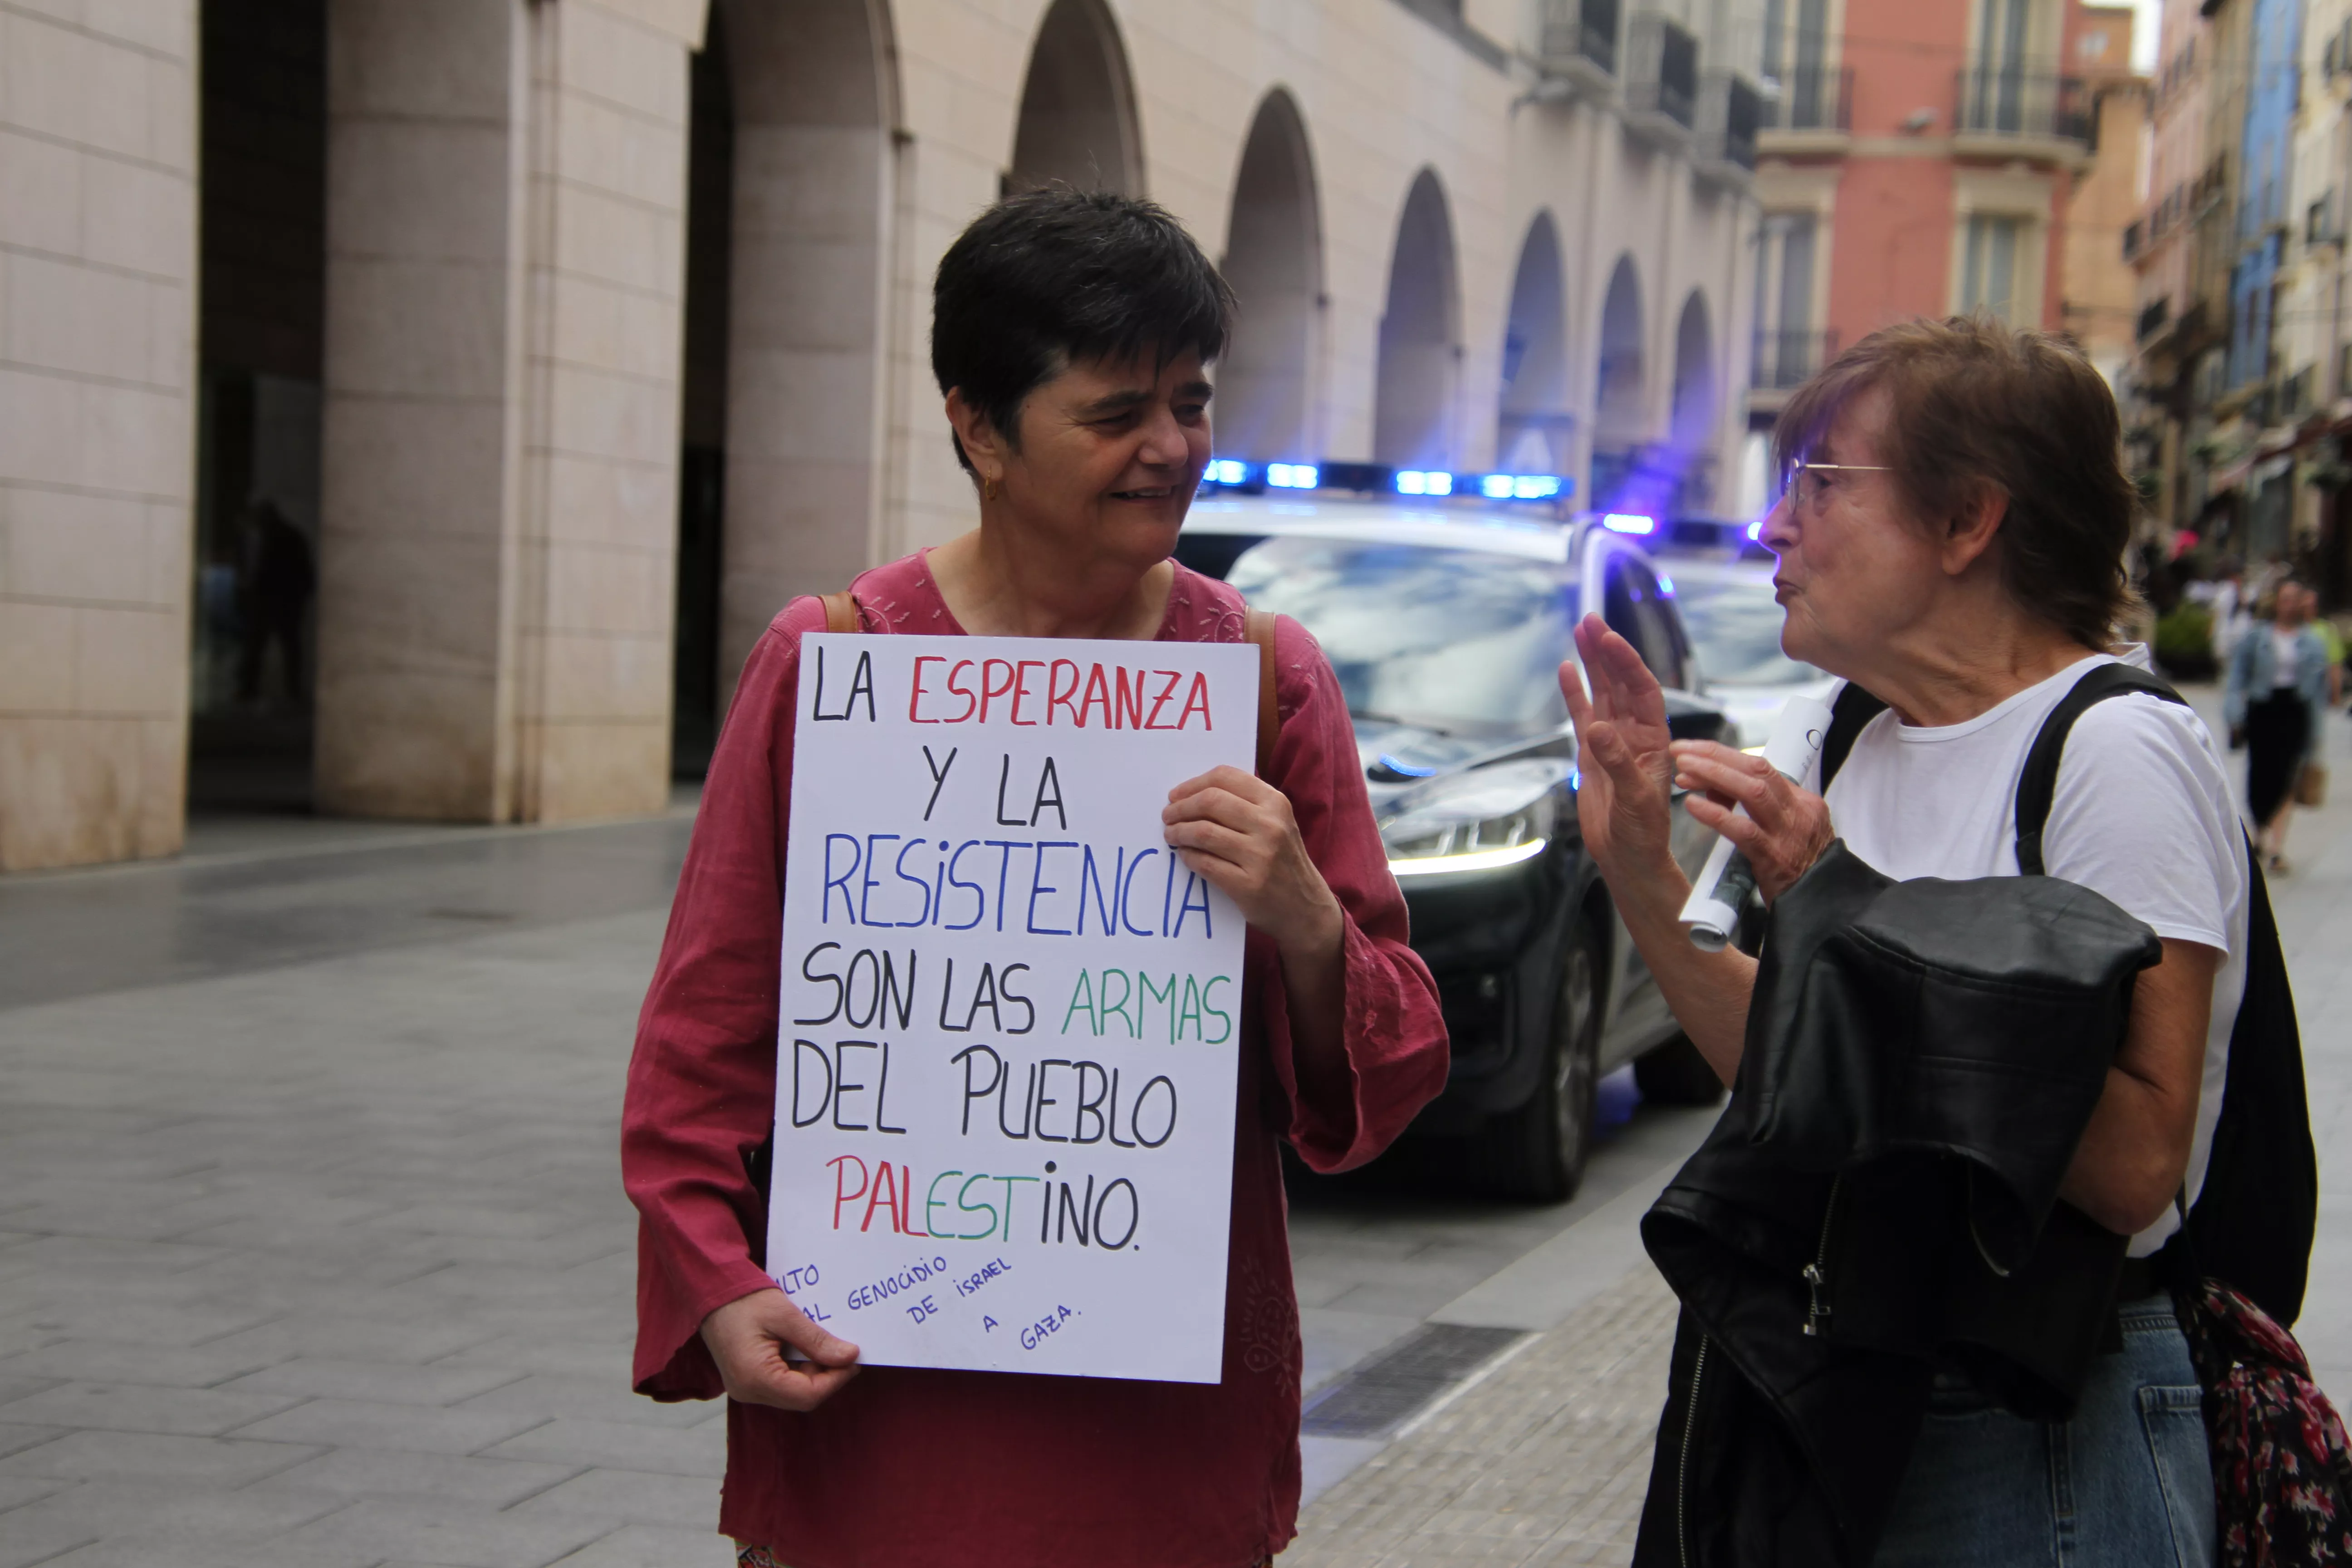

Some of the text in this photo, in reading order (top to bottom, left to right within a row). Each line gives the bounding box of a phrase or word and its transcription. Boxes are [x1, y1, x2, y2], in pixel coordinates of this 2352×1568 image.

[813, 646, 1211, 730] LA ESPERANZA
[923, 745, 1066, 830] Y LA
[793, 941, 1230, 1044] SON LAS ARMAS
[792, 1039, 1176, 1148] DEL PUEBLO
[776, 1264, 819, 1295] LTO
[907, 1295, 937, 1323] DE
[984, 1305, 1080, 1349] A GAZA.
